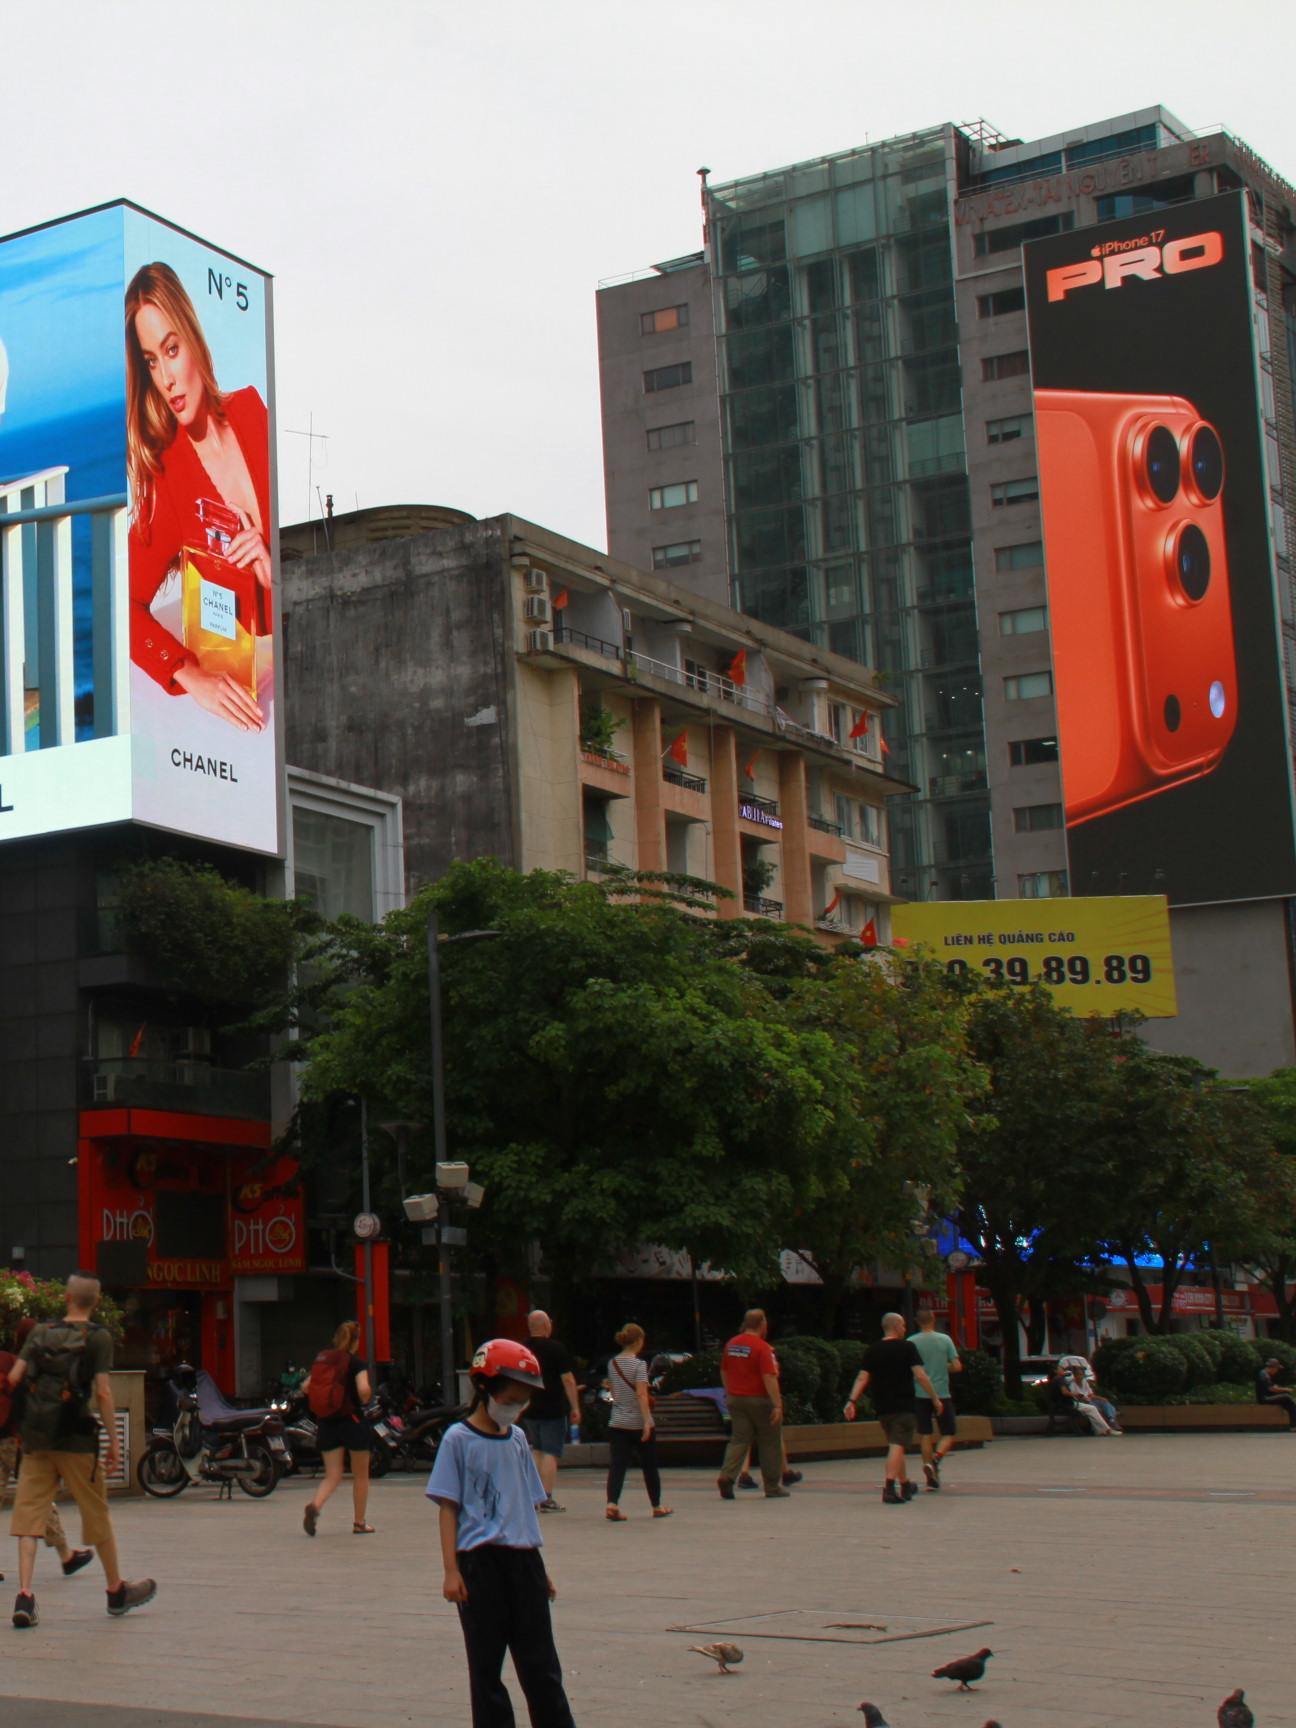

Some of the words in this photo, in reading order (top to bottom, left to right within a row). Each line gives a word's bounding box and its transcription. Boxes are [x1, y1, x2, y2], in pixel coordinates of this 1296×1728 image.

[1101, 236, 1149, 257] iPhone
[1149, 229, 1167, 245] 17
[1045, 229, 1226, 303] PRO
[203, 596, 233, 616] CHANEL
[171, 748, 238, 783] CHANEL
[944, 933, 973, 946] LIÊN
[978, 933, 994, 947] HỆ
[999, 930, 1044, 945] QUẢNG
[187, 1263, 221, 1283] LINH
